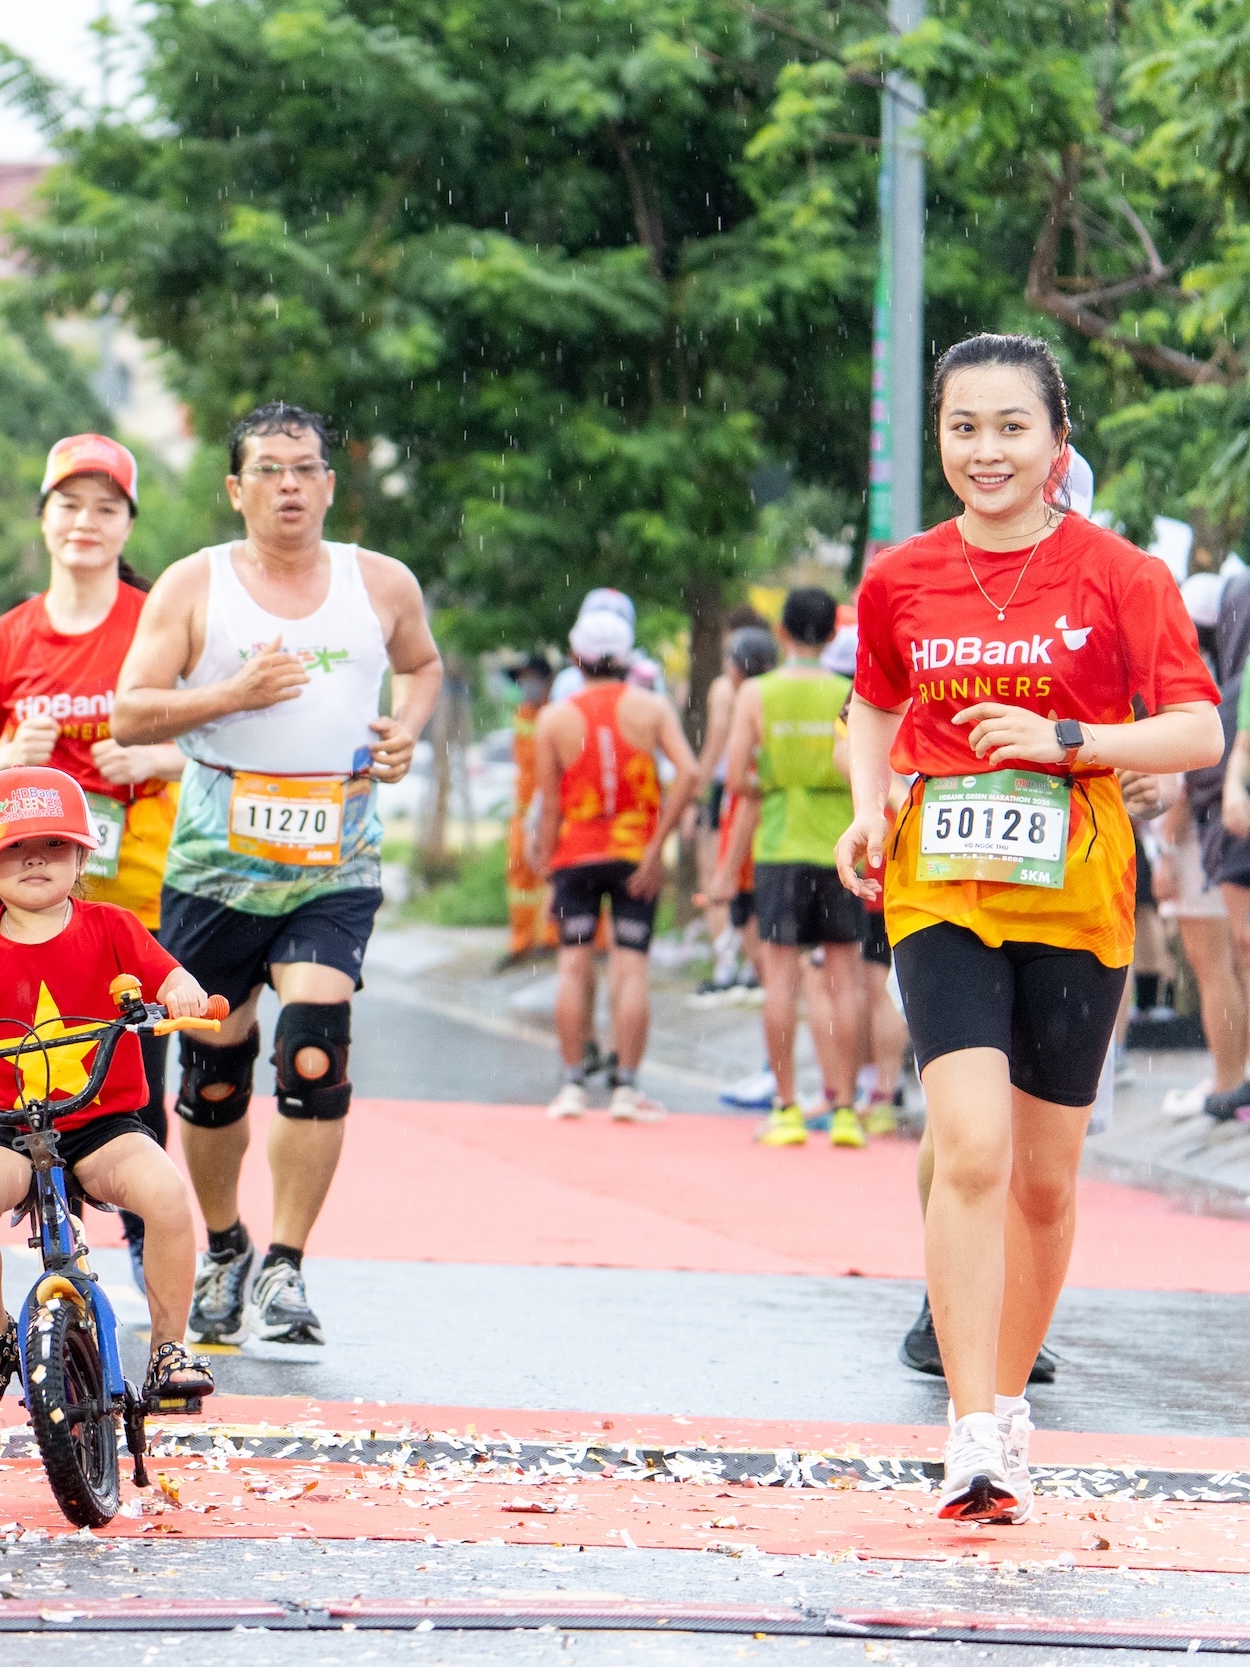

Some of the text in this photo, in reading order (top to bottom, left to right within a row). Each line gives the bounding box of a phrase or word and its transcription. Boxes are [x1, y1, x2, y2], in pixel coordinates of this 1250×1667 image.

[911, 635, 1054, 672] HDBank
[919, 676, 1052, 704] RUNNERS
[11, 787, 59, 801] HDBank
[989, 795, 1030, 803] MARATHON
[1032, 798, 1050, 806] 2026
[249, 806, 326, 833] 11270
[936, 807, 1046, 844] 50128
[1020, 869, 1050, 884] 5KM
